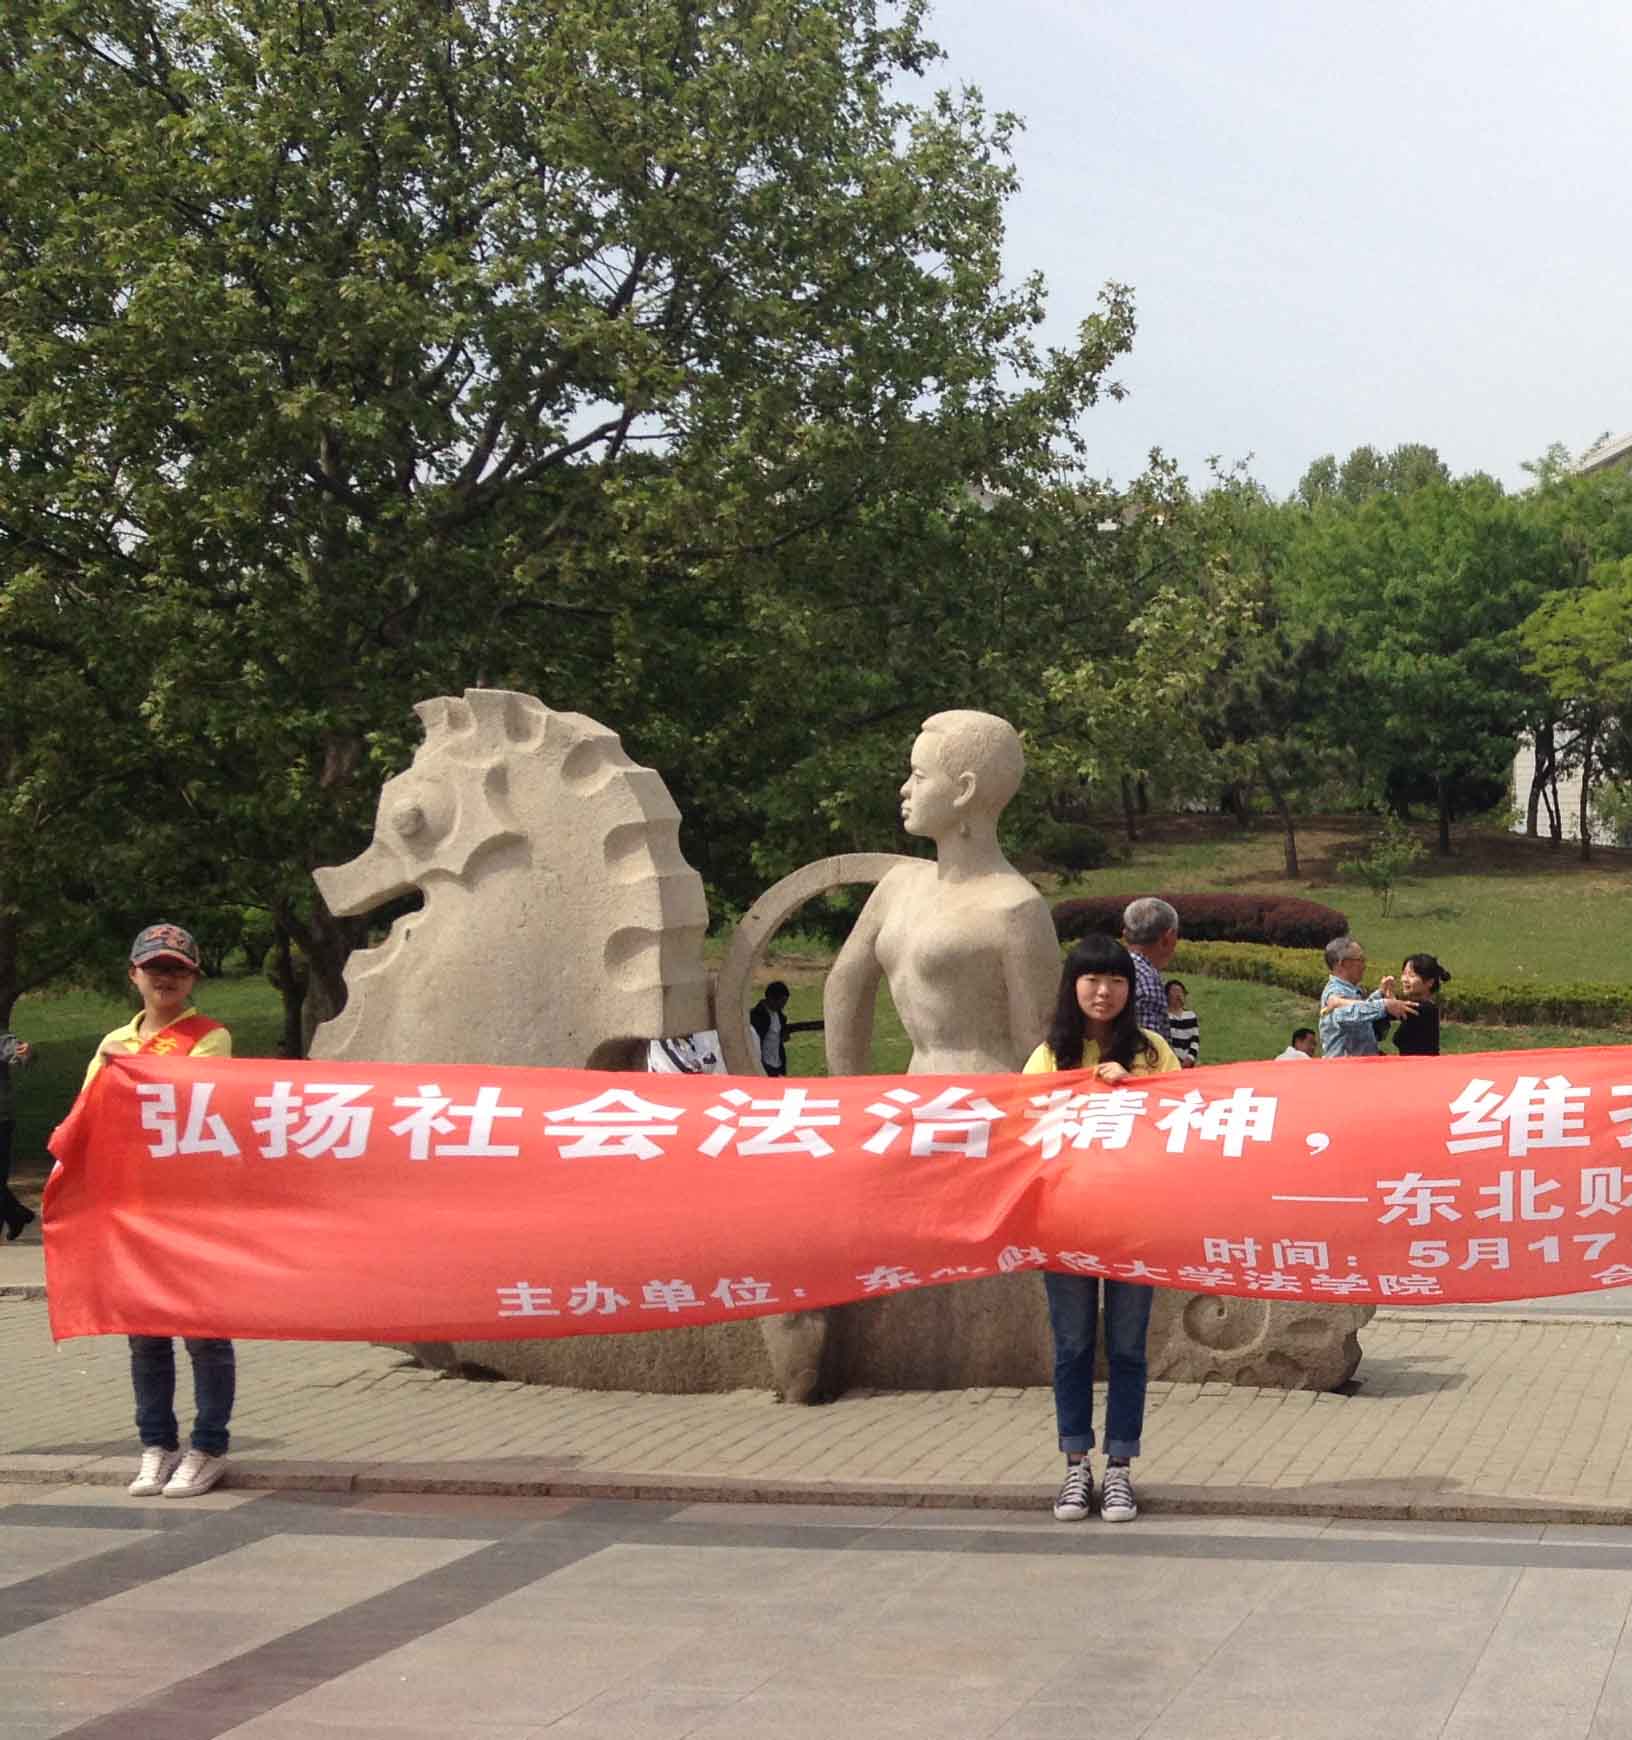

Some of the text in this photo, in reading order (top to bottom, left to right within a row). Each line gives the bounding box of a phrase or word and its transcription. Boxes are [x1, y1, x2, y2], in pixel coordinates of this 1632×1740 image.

[497, 1246, 1444, 1318] 主办单位：东财经大学法学院
